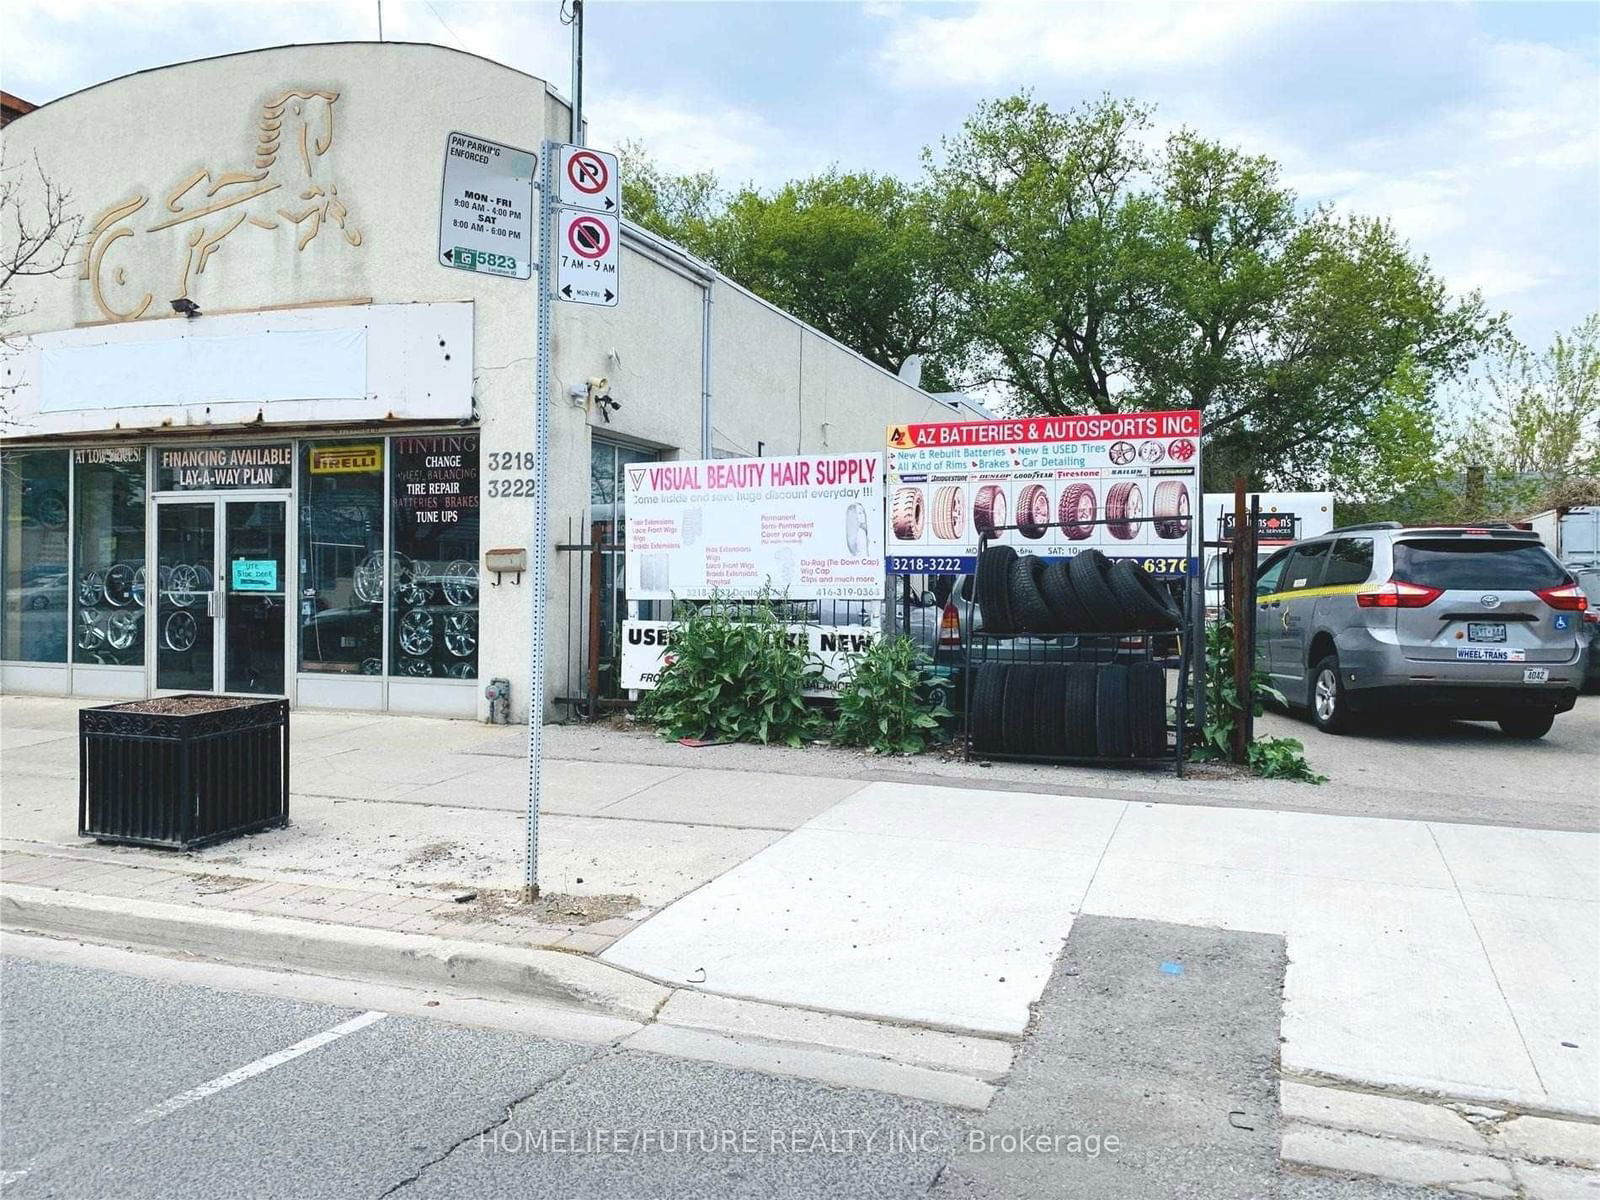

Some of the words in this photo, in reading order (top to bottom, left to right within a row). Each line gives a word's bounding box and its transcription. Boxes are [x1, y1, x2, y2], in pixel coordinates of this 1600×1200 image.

[451, 136, 467, 147] PAY
[450, 147, 489, 164] ENFORCED
[464, 190, 488, 203] MON
[496, 198, 512, 208] FRI
[454, 198, 470, 209] 9:00
[471, 202, 485, 212] AM
[492, 207, 508, 217] 4:00
[509, 210, 522, 220] PM
[478, 214, 497, 225] SAT
[452, 219, 469, 229] 8:00
[470, 223, 484, 233] AM
[491, 227, 507, 237] 6:00
[508, 230, 521, 240] PM
[477, 253, 517, 270] 5823
[562, 256, 568, 267] 7
[571, 260, 584, 269] AM
[594, 260, 600, 271] 9
[603, 264, 615, 273] AM
[917, 428, 936, 445] AZ
[940, 424, 1024, 444] BATTERIES
[1028, 423, 1039, 439] &
[1043, 417, 1157, 439] AUTOSPORTS
[1162, 416, 1198, 434] INC.
[399, 436, 476, 454] TINTING
[898, 452, 916, 460] New
[929, 449, 960, 459] Rebuilt
[964, 447, 1006, 458] Batteries
[1018, 447, 1038, 455] New
[1052, 444, 1077, 454] USED
[1081, 443, 1106, 453] Tires
[163, 451, 226, 467] FINANCING
[230, 448, 291, 466] AVAILABLE
[313, 450, 376, 469] PIRELLI
[425, 455, 462, 468] CHANGE
[488, 451, 535, 471] 3218
[897, 461, 909, 471] All
[911, 461, 931, 471] Kind
[934, 461, 943, 470] of
[945, 459, 967, 469] Rims
[979, 459, 1010, 469] Brakes
[1022, 458, 1037, 467] Car
[1041, 456, 1085, 468] Detailing
[179, 469, 242, 486] LAY-A-WAY
[243, 468, 273, 485] PLAN
[427, 468, 477, 480] BALANCING
[649, 466, 701, 492] VISUAL
[707, 463, 766, 490] BEAUTY
[771, 461, 810, 487] HAIR
[816, 458, 877, 486] SUPPLY
[406, 483, 426, 495] TIRE
[429, 482, 460, 495] REPAIR
[488, 479, 535, 498] 3222
[661, 491, 687, 503] inside
[690, 492, 709, 502] and
[737, 491, 762, 503] huge
[765, 489, 808, 500] discount
[811, 487, 860, 499] everyday
[863, 487, 873, 497] !!!
[445, 495, 479, 508] BRAKES
[416, 510, 439, 523] TUNE
[441, 510, 458, 522] UPS
[778, 522, 814, 530] Permanent
[782, 532, 796, 540] your
[1048, 546, 1065, 555] SAT:
[861, 558, 880, 567] Cap)
[894, 559, 961, 571] 3218-3222
[815, 567, 830, 577] Cap
[801, 576, 818, 585] Clips
[834, 575, 854, 583] much
[821, 634, 873, 652] NEW
[1457, 650, 1508, 660] WHEEL-TRANS
[640, 673, 663, 683] FRO
[1528, 671, 1544, 680] 4042
